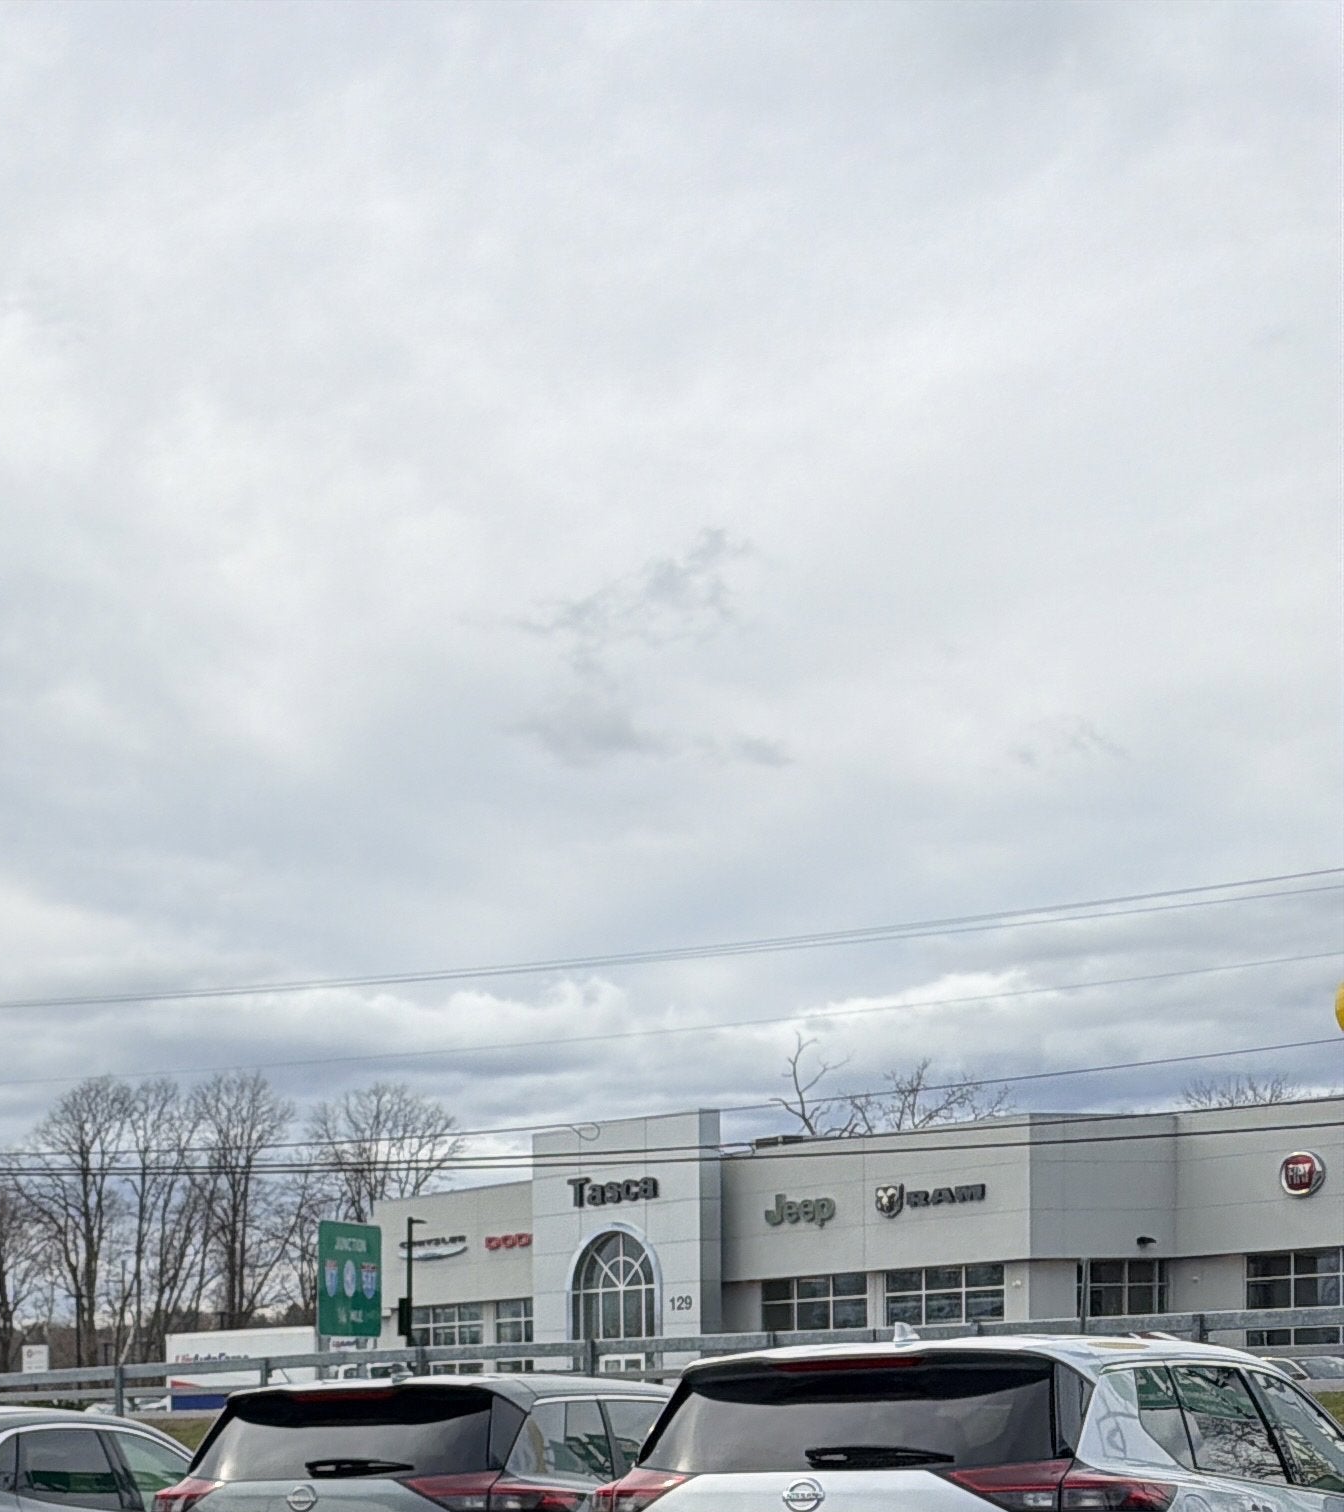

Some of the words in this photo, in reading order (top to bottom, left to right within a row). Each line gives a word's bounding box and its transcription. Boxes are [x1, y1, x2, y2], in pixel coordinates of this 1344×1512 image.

[567, 1176, 660, 1208] Tasca
[906, 1183, 986, 1208] RAM
[764, 1193, 836, 1229] Jeep
[669, 1295, 692, 1311] 129
